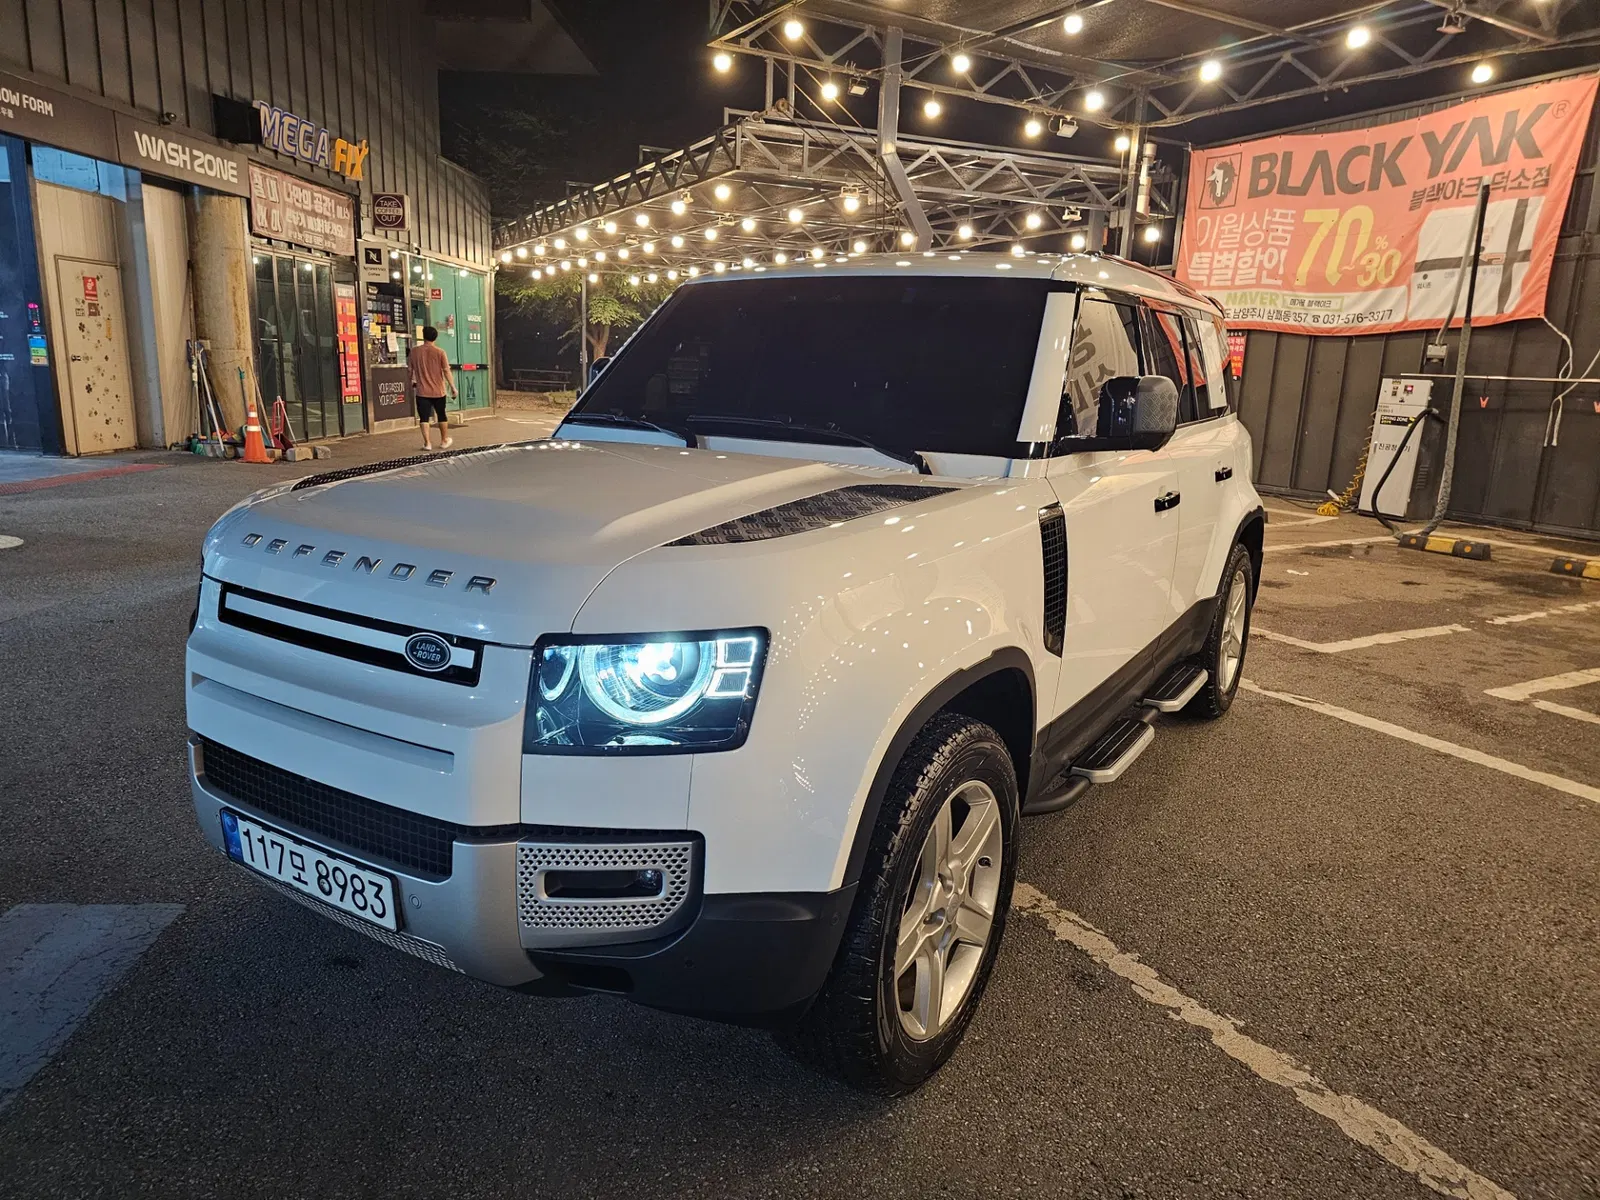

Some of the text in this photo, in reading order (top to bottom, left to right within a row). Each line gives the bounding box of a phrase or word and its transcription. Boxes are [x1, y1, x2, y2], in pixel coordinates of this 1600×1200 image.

[0, 87, 54, 117] OW FORM
[134, 131, 238, 184] WASH ZONE
[252, 100, 369, 181] MEGA FIX
[1247, 135, 1412, 200] BLACK
[1420, 102, 1553, 180] YAK
[380, 200, 398, 208] TAKE
[1408, 163, 1553, 212] 블랙야크 덕소점
[381, 214, 396, 222] OUT
[1196, 208, 1296, 249] 이월상품
[1187, 246, 1288, 287] 특별할인
[1225, 291, 1280, 307] NAVER
[1233, 307, 1266, 320] 남양주시
[1292, 312, 1308, 323] 357
[1322, 309, 1393, 325] 031-576-3377
[1378, 443, 1411, 452] 진공청기
[240, 533, 498, 595] DEFENDER
[243, 828, 387, 919] 117모 8983
